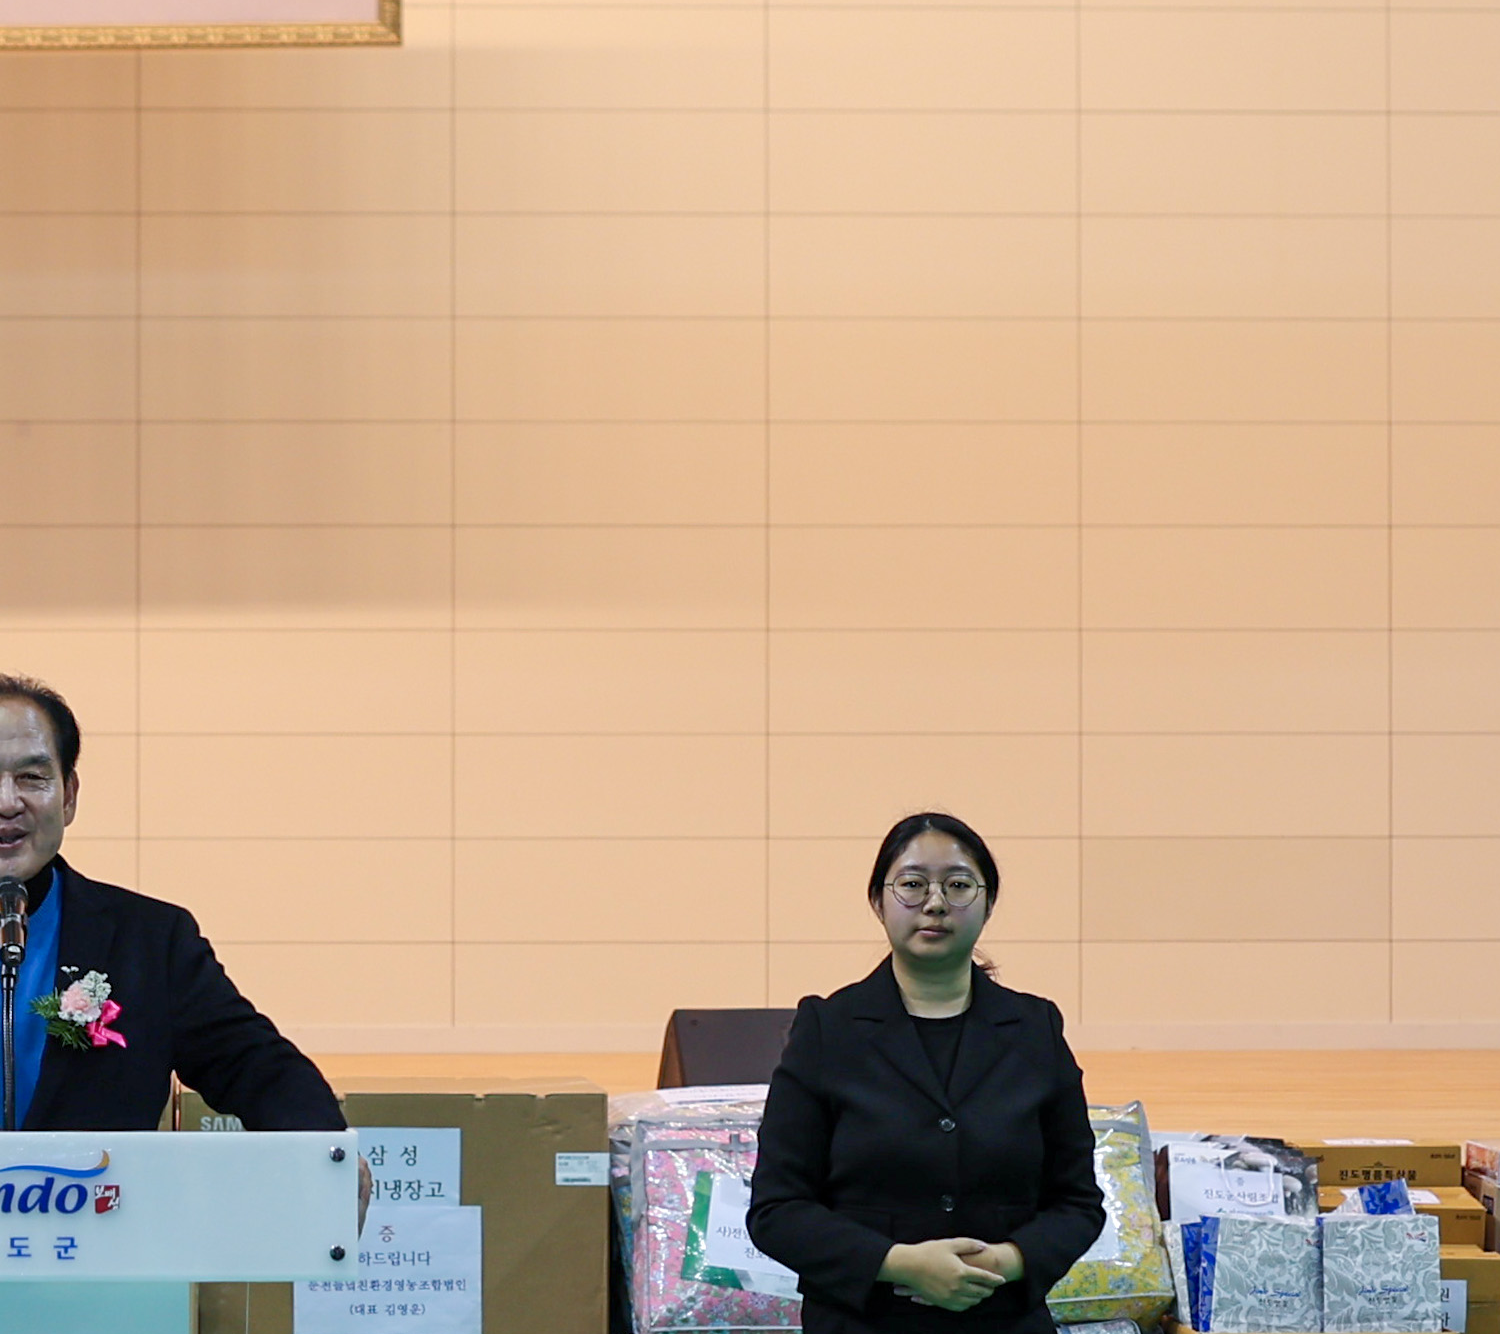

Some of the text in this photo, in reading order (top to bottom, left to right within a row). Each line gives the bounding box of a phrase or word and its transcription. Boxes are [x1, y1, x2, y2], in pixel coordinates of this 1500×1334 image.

[370, 1179, 446, 1201] 냉장고
[379, 1225, 396, 1244] 증
[357, 1250, 432, 1267] 하드립니다
